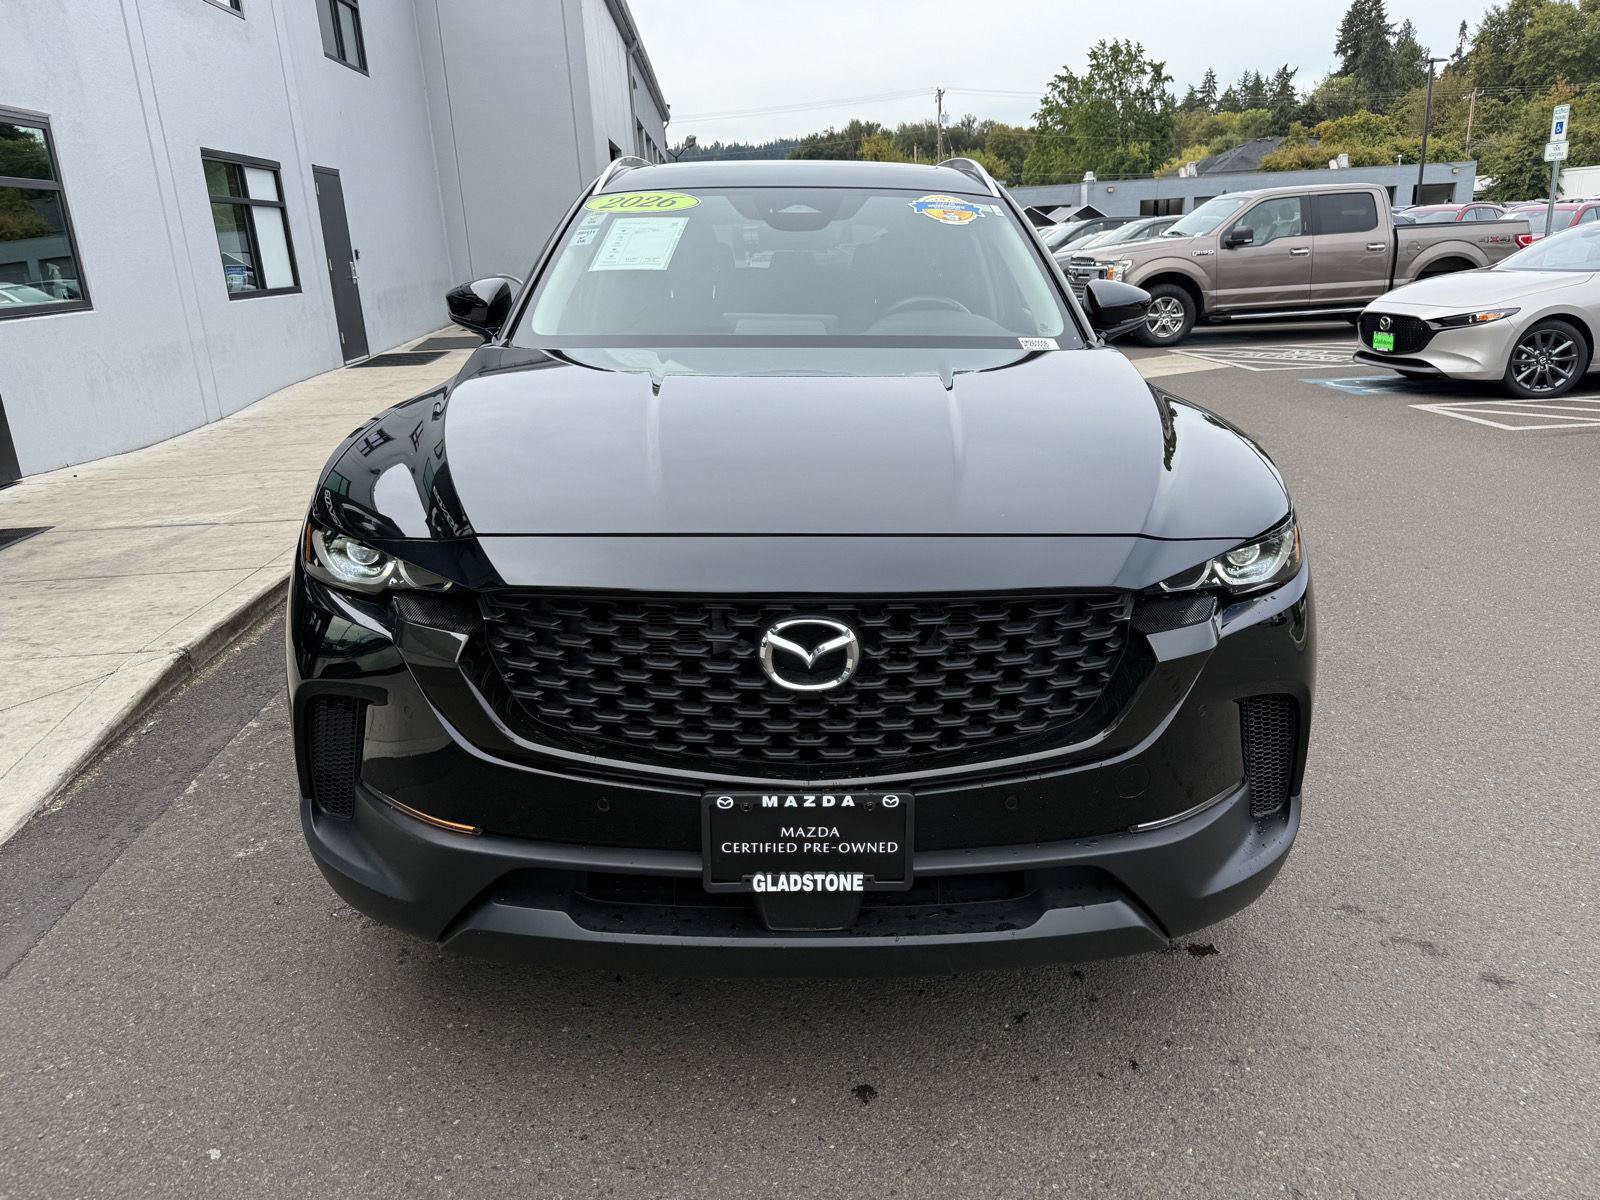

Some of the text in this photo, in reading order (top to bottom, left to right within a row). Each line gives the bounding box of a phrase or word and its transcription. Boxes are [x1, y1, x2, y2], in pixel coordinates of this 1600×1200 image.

[598, 195, 682, 208] 2026
[762, 795, 855, 807] MAZDA
[780, 826, 840, 838] MAZDA
[721, 842, 899, 853] CERTIFIED PRE-OWNED
[752, 873, 864, 892] GLADSTONE
